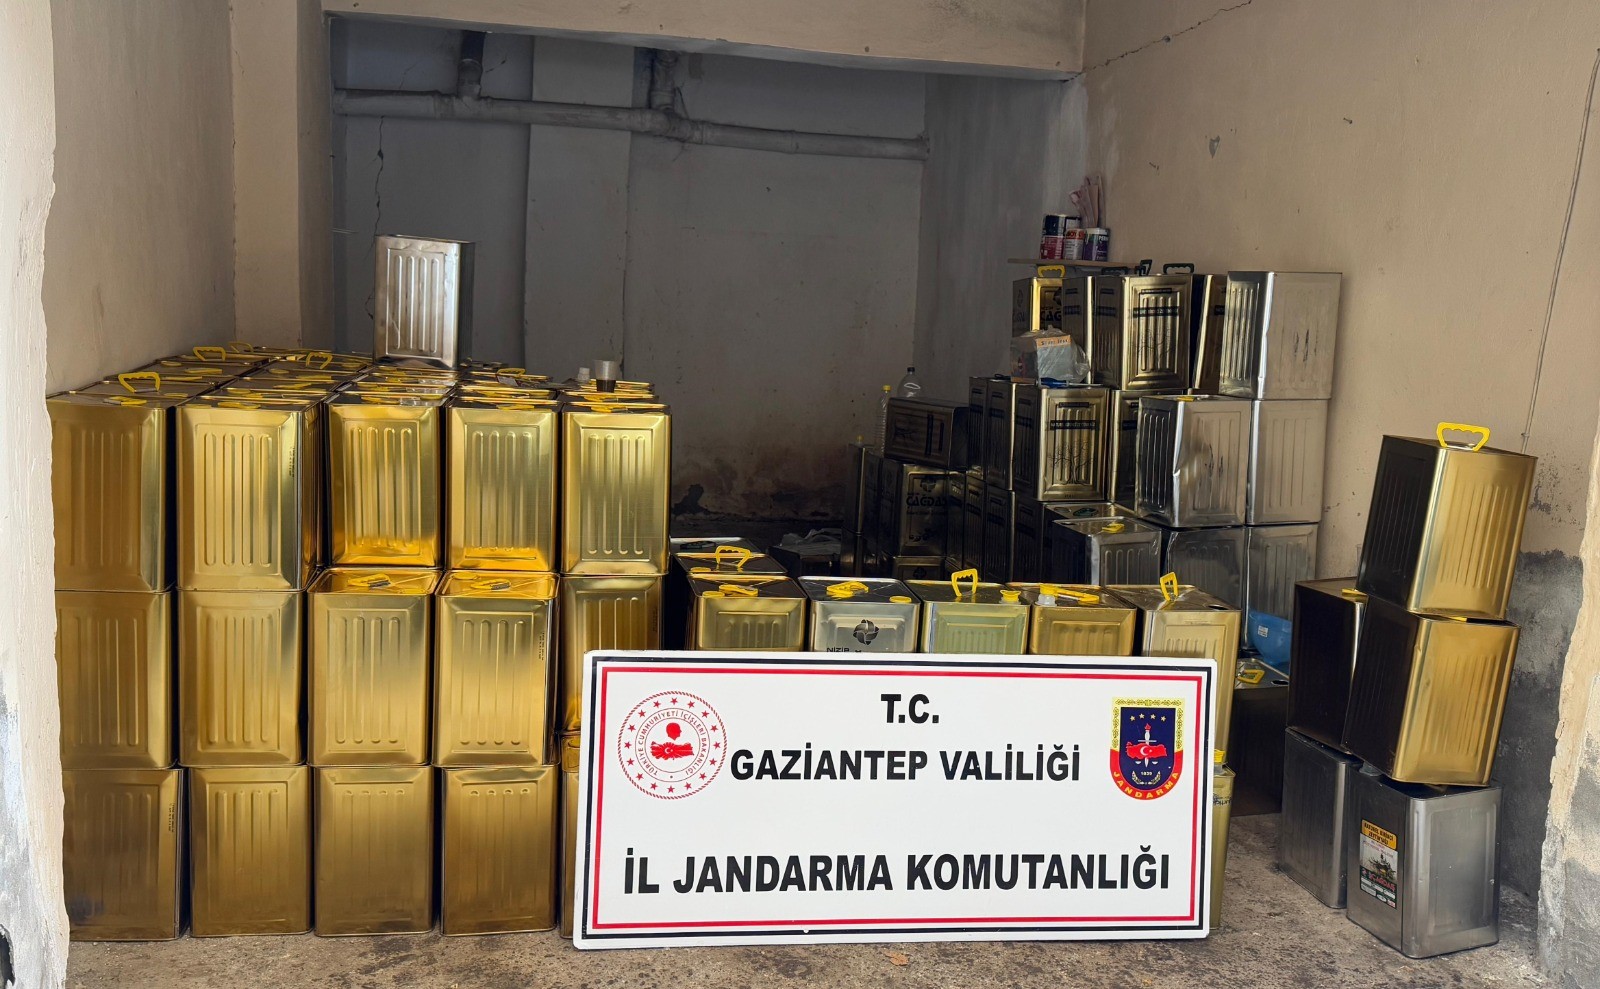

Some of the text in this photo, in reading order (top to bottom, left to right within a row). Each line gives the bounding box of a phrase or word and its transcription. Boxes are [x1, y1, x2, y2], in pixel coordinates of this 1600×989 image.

[881, 694, 939, 723] T.C.
[637, 710, 708, 776] TÜRKİYE CUMHURİYETİ İÇİŞLERİ BAKANLIĞI
[731, 743, 1079, 781] GAZİANTEP VALİLİĞİ
[1113, 771, 1179, 799] JANDARMA
[625, 845, 1169, 894] İL JANDARMA KOMUTANLIĞI
